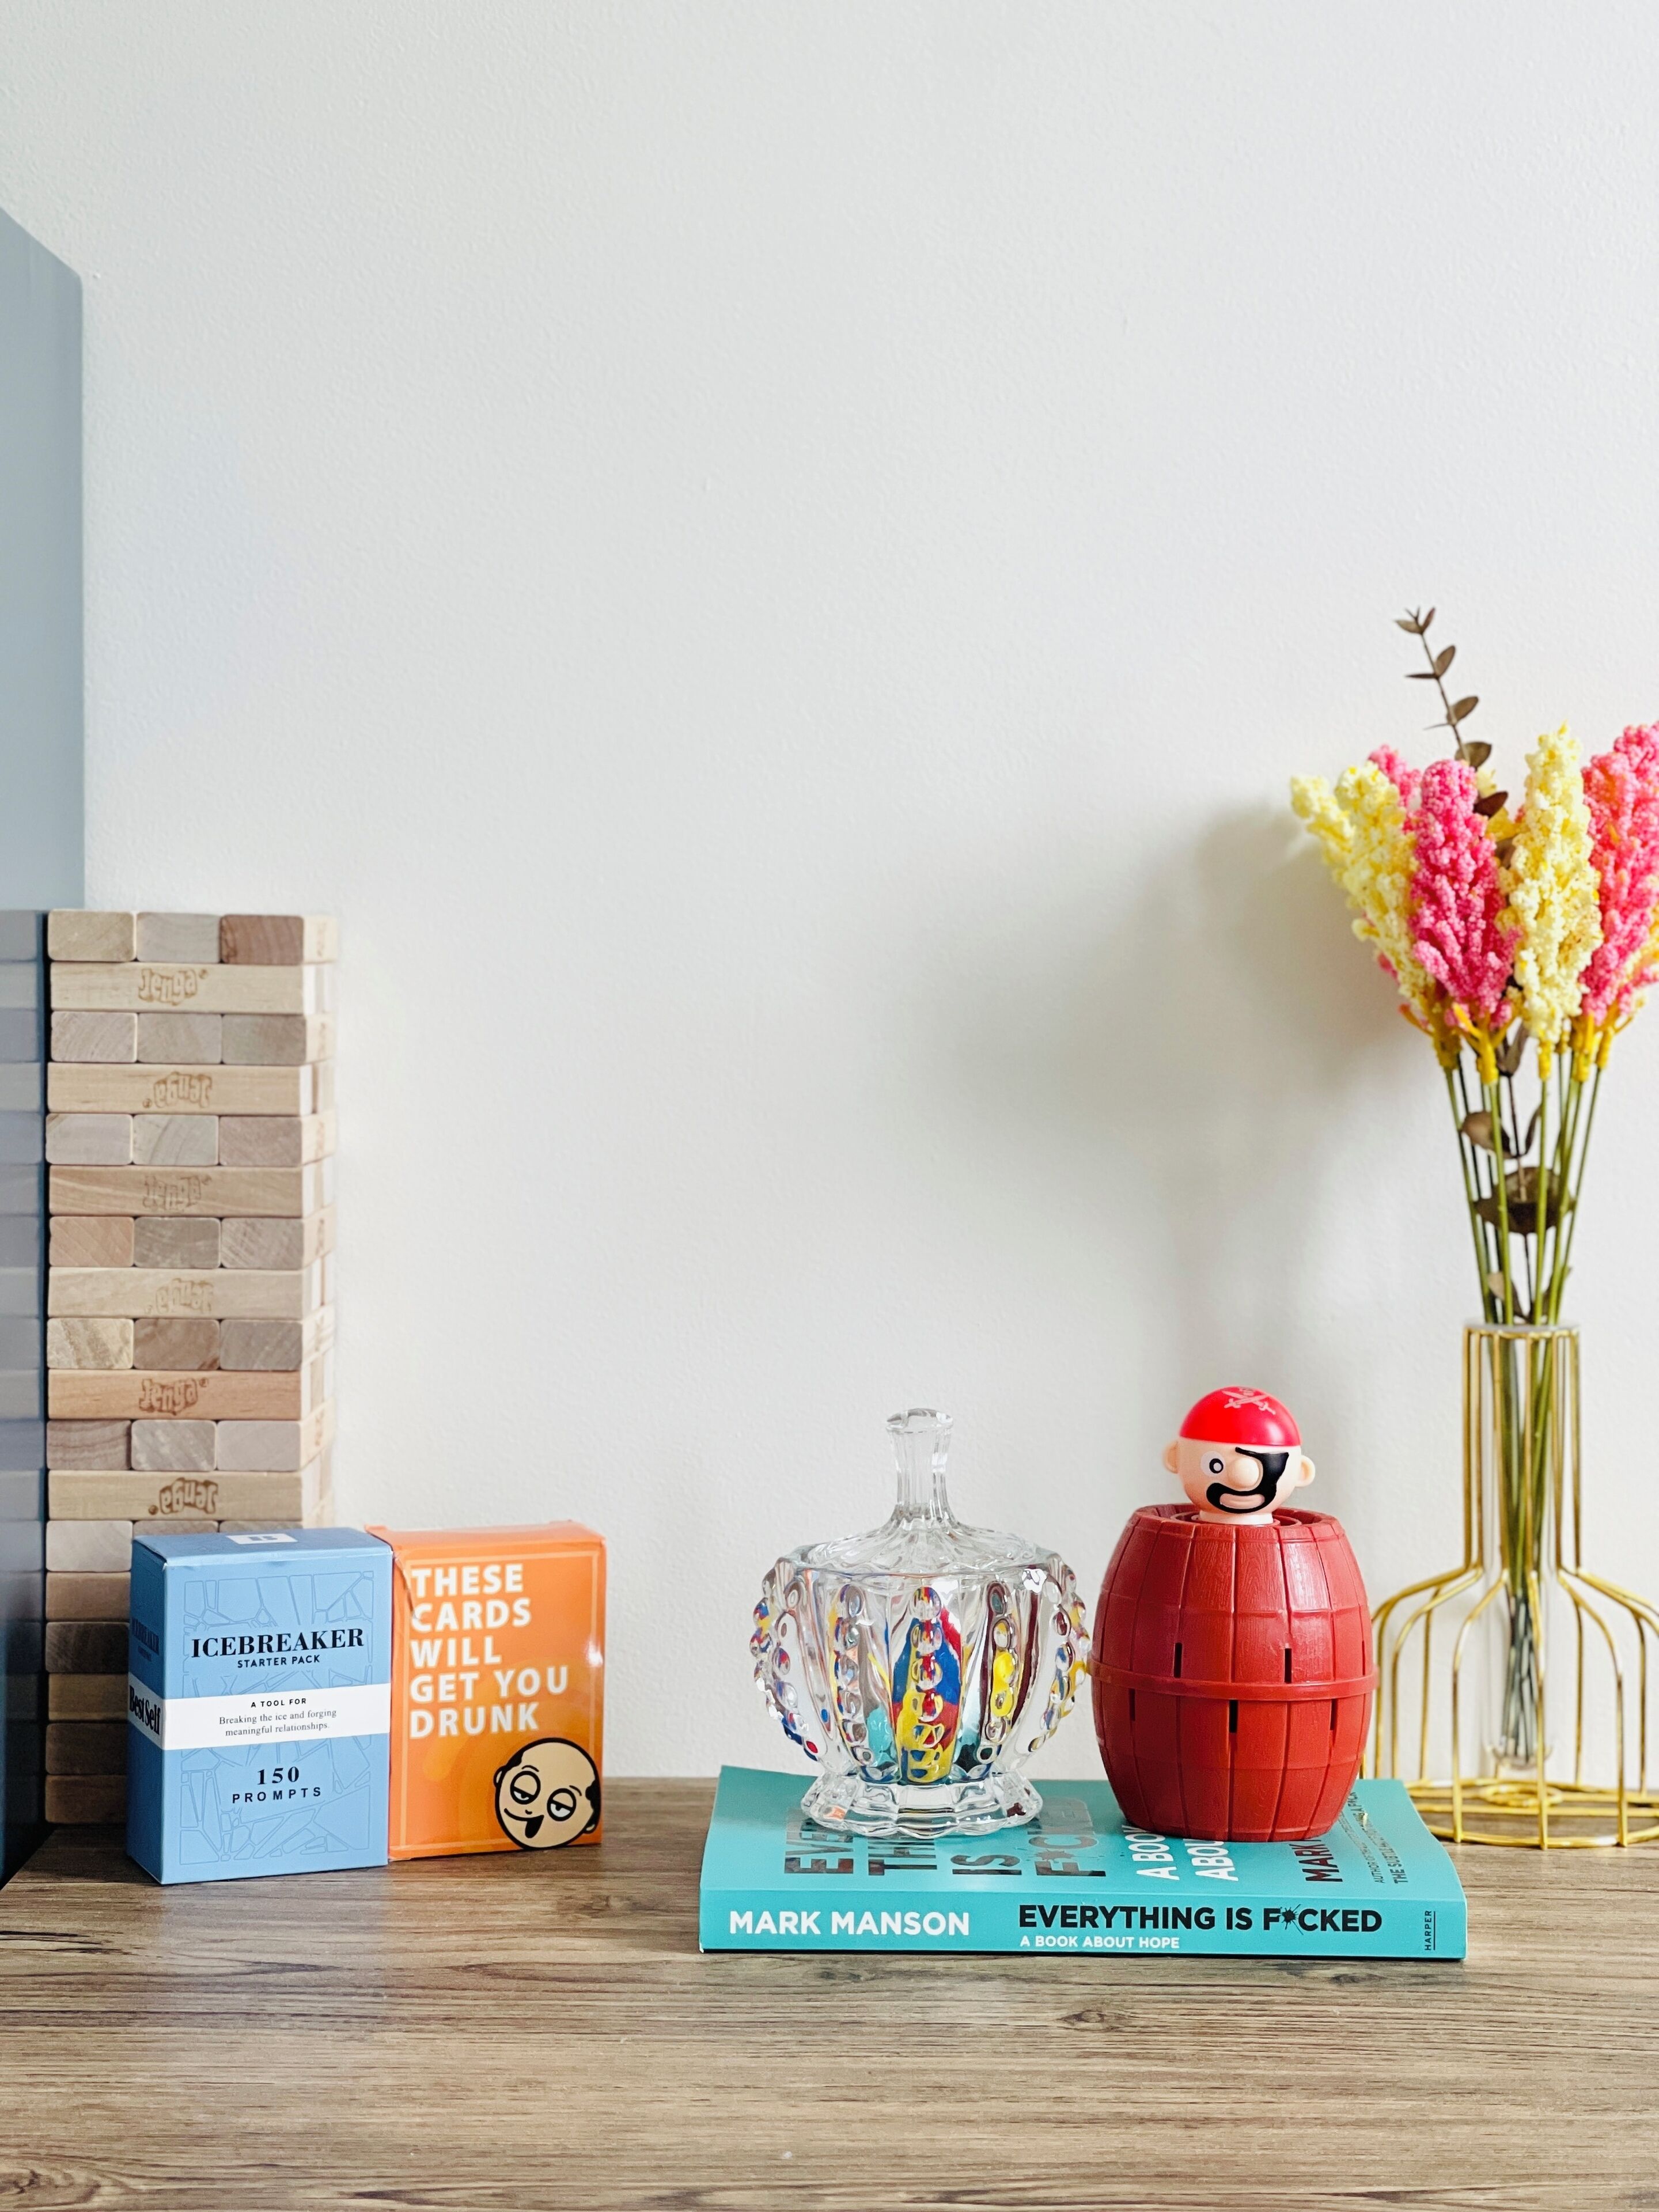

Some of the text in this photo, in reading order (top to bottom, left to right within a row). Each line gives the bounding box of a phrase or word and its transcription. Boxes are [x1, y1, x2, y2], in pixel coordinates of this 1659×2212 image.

[138, 968, 198, 1006] Jenga
[154, 1071, 212, 1109] Jenga
[139, 1378, 198, 1415] Jenga
[160, 1478, 218, 1514] Jenga
[411, 1563, 524, 1598] THESE
[411, 1597, 532, 1633] CARDS
[191, 1628, 364, 1658] ICEBREAKER
[410, 1635, 502, 1669] WILL
[237, 1654, 320, 1668] STARTER PACK
[410, 1665, 568, 1704] GET YOU
[219, 1709, 337, 1725] Breaking the ice and forging
[260, 1699, 285, 1707] TOOL
[225, 1722, 330, 1736] meaningful relationships.
[410, 1702, 539, 1739] DRUNK
[257, 1766, 300, 1785] 150
[232, 1787, 321, 1804] PROMPTS
[950, 1854, 1022, 1876] IS
[1136, 1866, 1180, 1881] A
[1183, 1838, 1239, 1881] ABOU
[1289, 1844, 1343, 1883] MARK
[1367, 1861, 1385, 1884] AUTHOR
[1389, 1869, 1409, 1884] THE
[729, 1911, 969, 1936] MARK MANSON
[1019, 1905, 1215, 1930] EVERYTHING
[1226, 1907, 1253, 1931] IS
[1424, 1910, 1433, 1951] HARPER
[1020, 1936, 1180, 1949] A BOOK ABOUT HOPE
